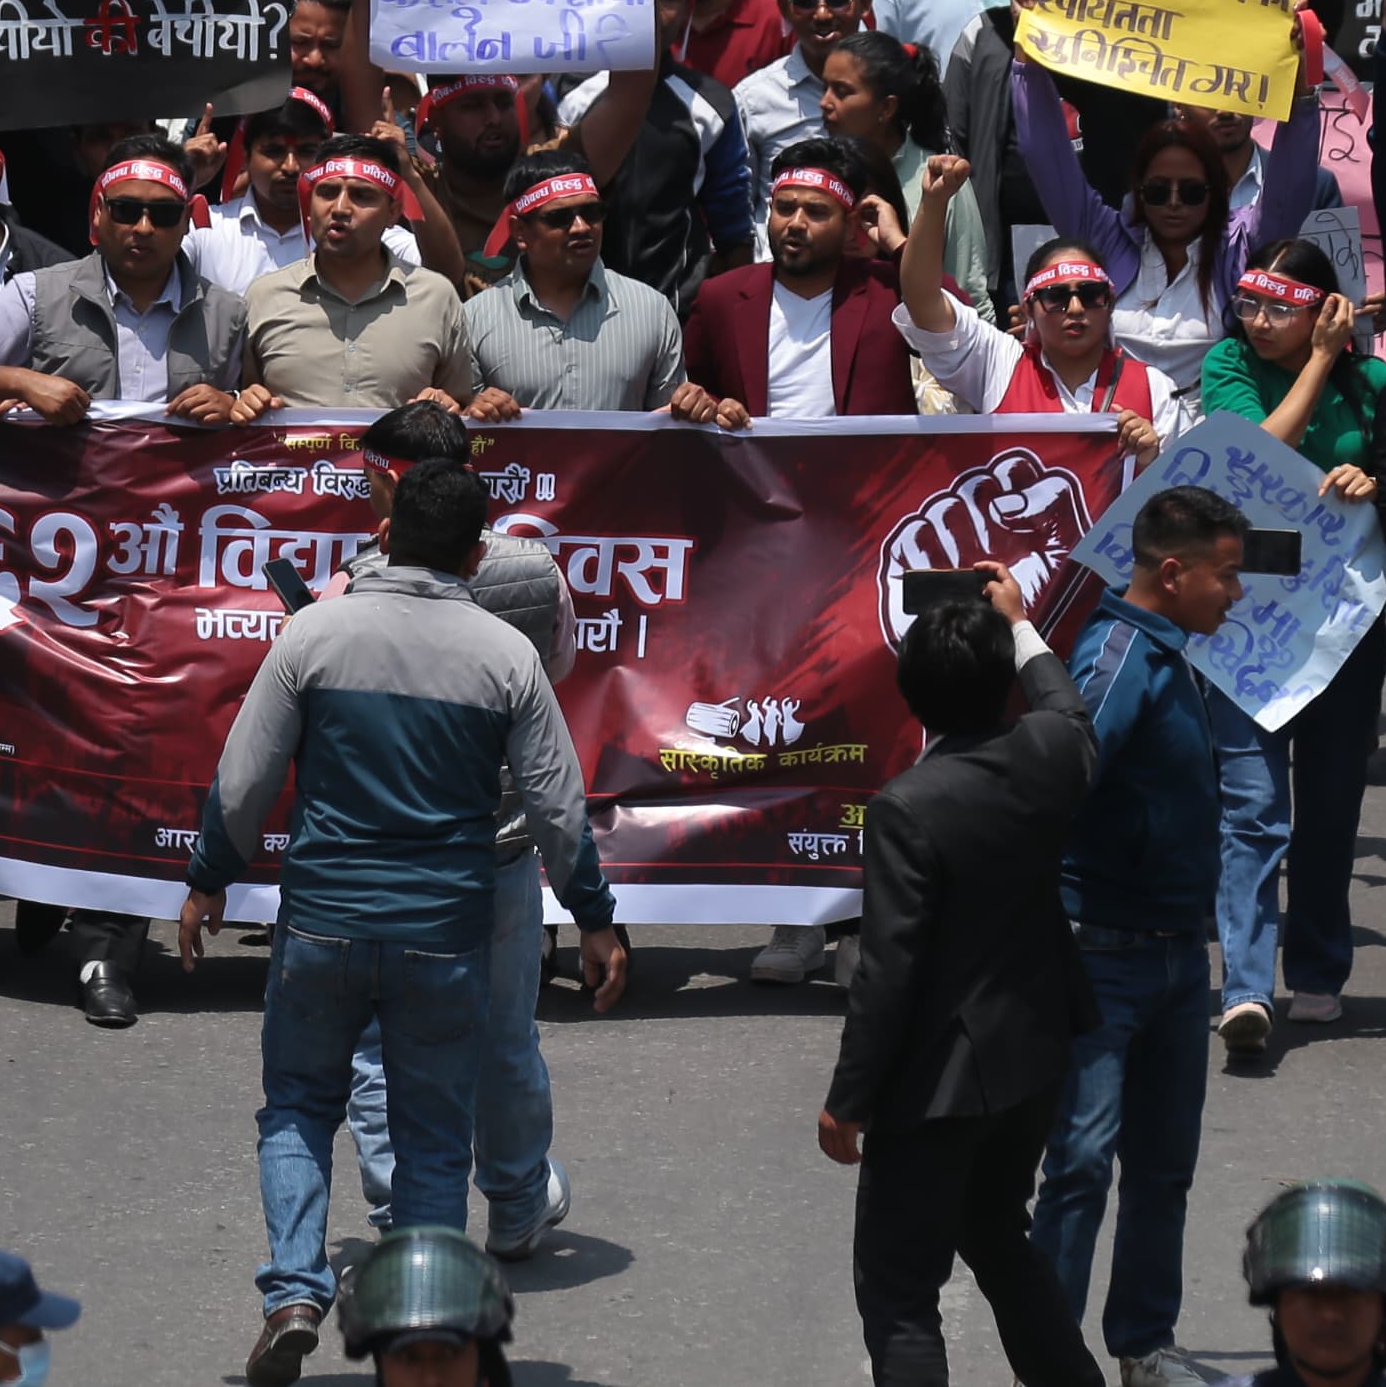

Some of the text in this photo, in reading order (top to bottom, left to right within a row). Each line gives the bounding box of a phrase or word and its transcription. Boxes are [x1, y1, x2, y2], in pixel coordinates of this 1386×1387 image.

[391, 6, 512, 62] बालेन
[550, 175, 583, 194] विरुद्ध
[1058, 262, 1089, 278] विरुद्ध
[1255, 273, 1287, 296] विरुद्ध
[215, 460, 306, 496] प्रतिबन्ध
[778, 741, 868, 767] कार्यक्रम
[787, 827, 850, 860] संयुक्त
